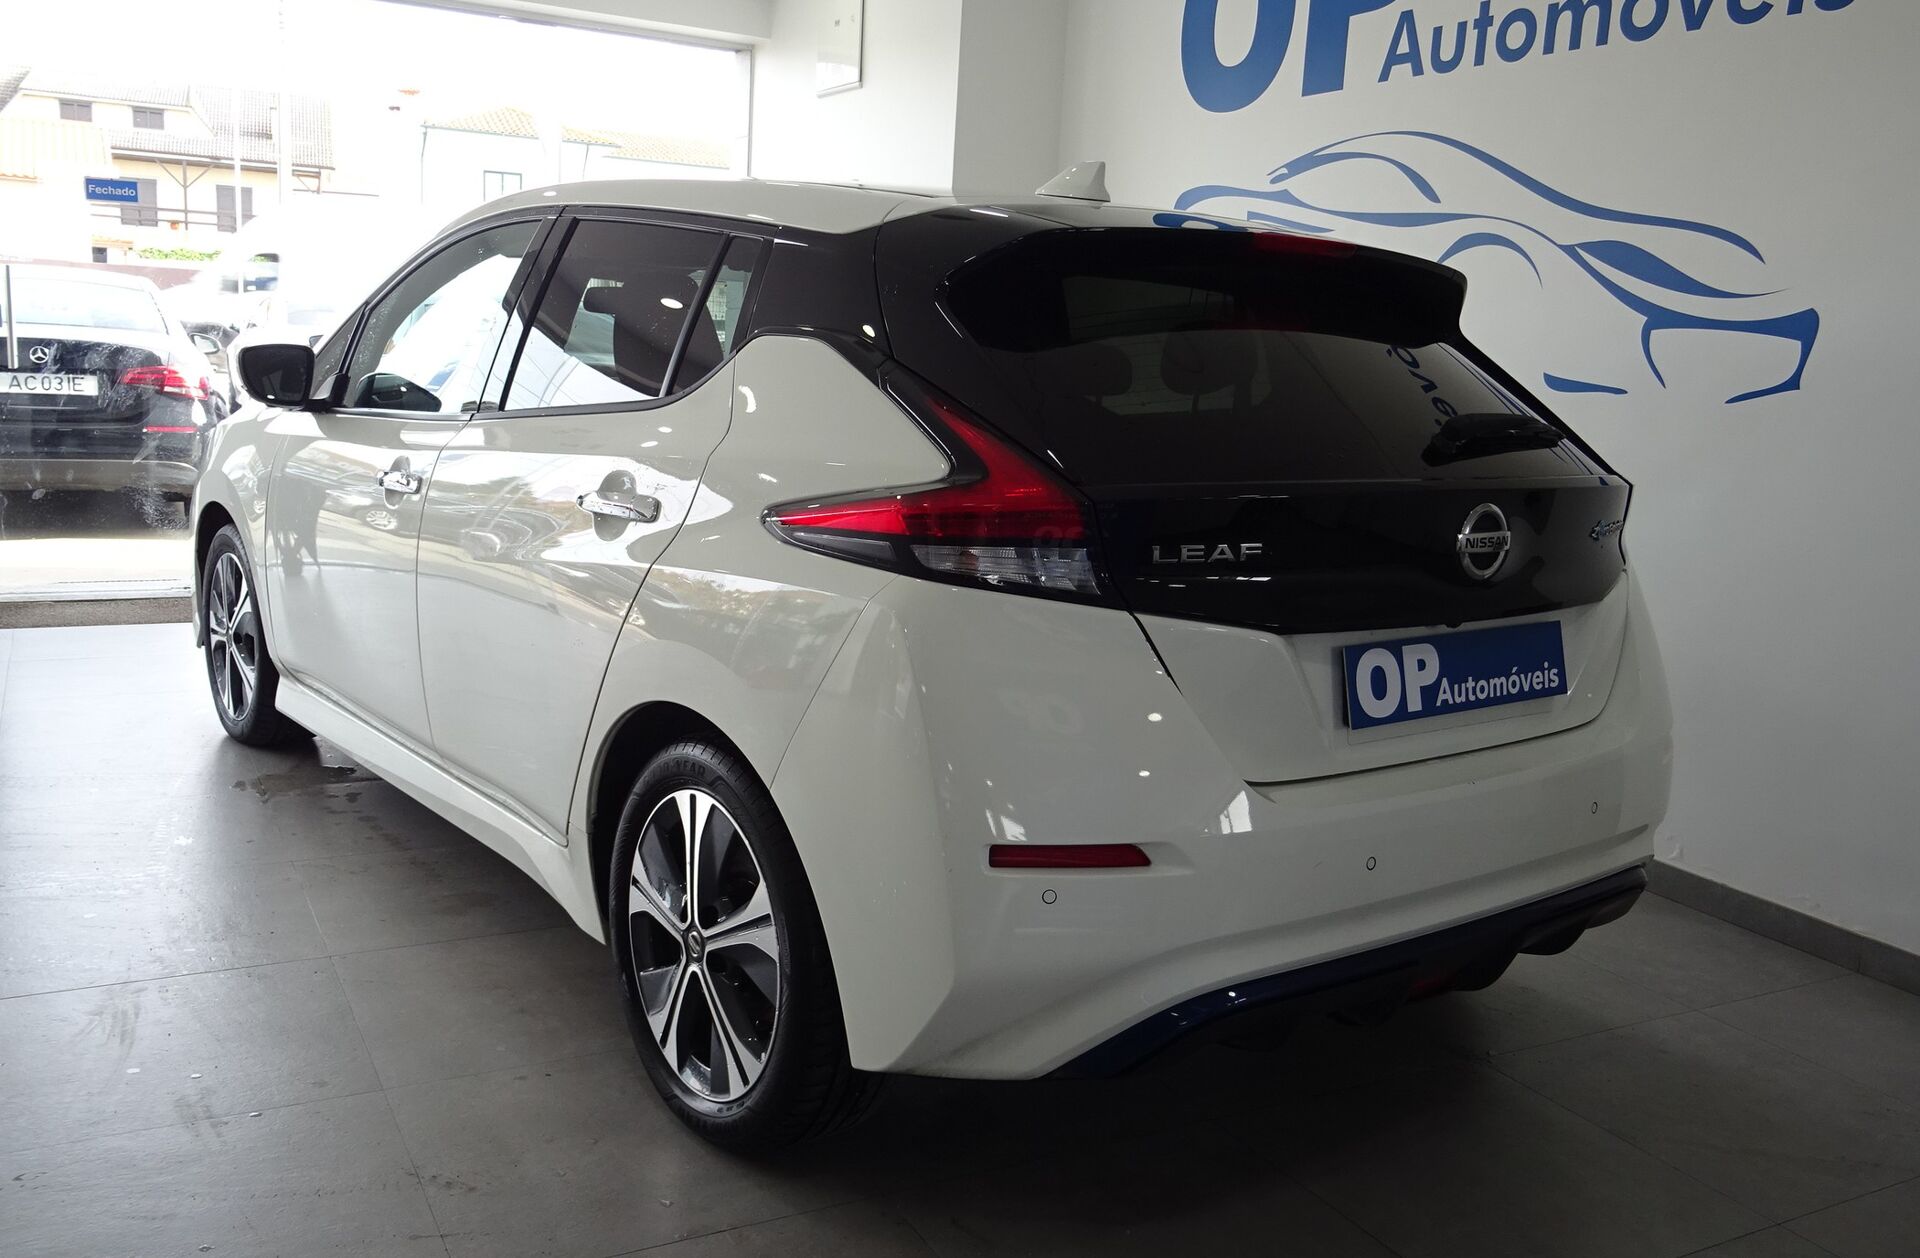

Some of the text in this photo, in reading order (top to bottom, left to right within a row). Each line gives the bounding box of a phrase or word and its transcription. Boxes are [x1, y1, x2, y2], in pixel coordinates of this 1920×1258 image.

[1378, 0, 1855, 83] Automóv
[88, 184, 136, 197] Fechado
[1465, 535, 1509, 549] NISSAN
[1151, 543, 1263, 565] LEAF
[1356, 643, 1560, 718] OP Automóveis
